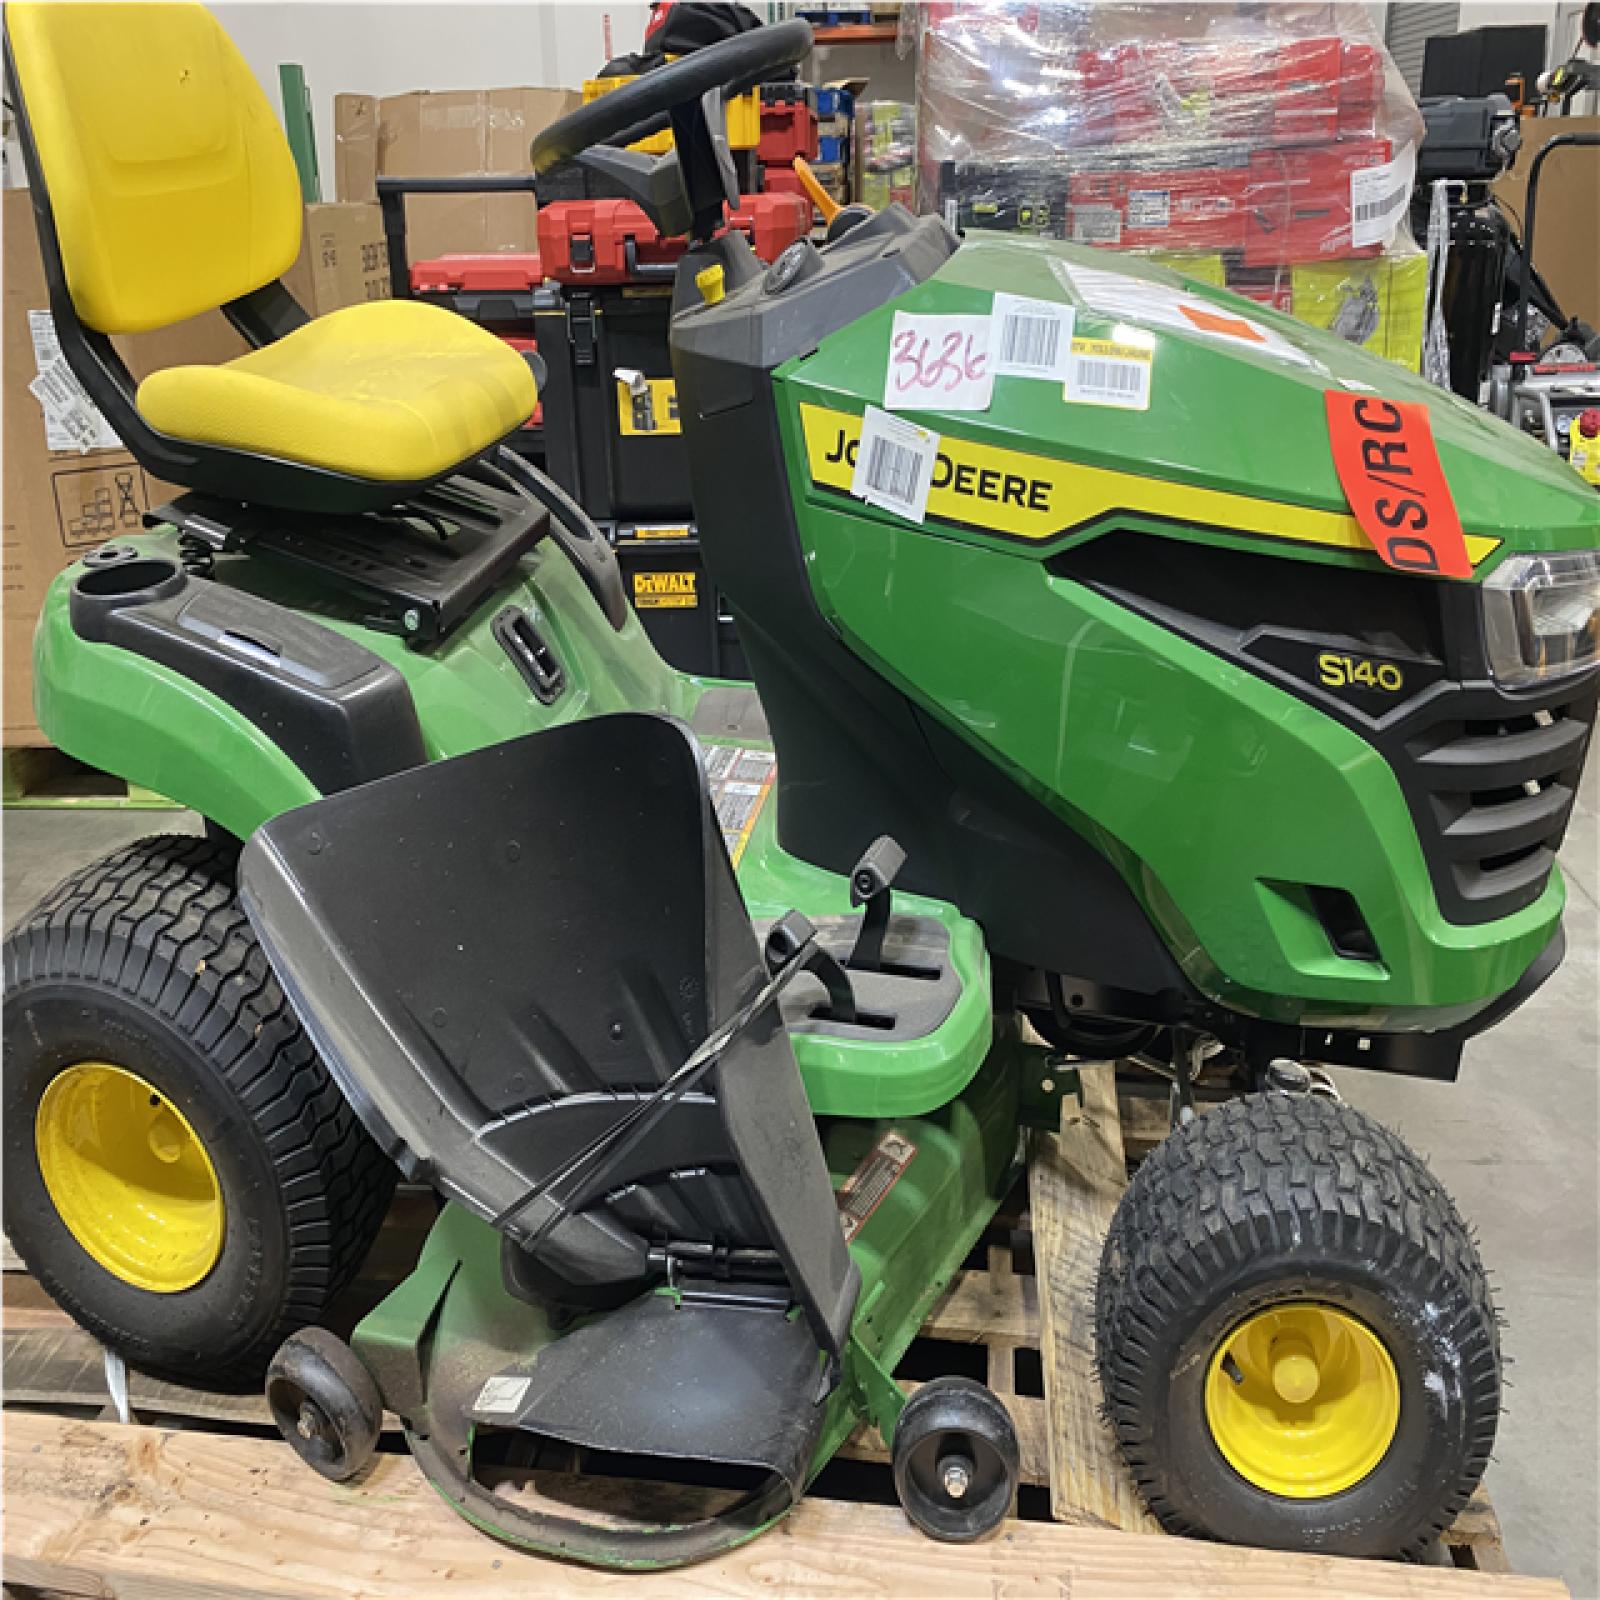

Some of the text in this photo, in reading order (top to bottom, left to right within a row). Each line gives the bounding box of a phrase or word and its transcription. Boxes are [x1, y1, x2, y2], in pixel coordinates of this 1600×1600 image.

[893, 329, 988, 392] 3636
[930, 451, 1054, 512] DEERE
[1354, 399, 1440, 571] DS/RC
[633, 573, 696, 593] DEWALT
[1318, 653, 1403, 692] S140
